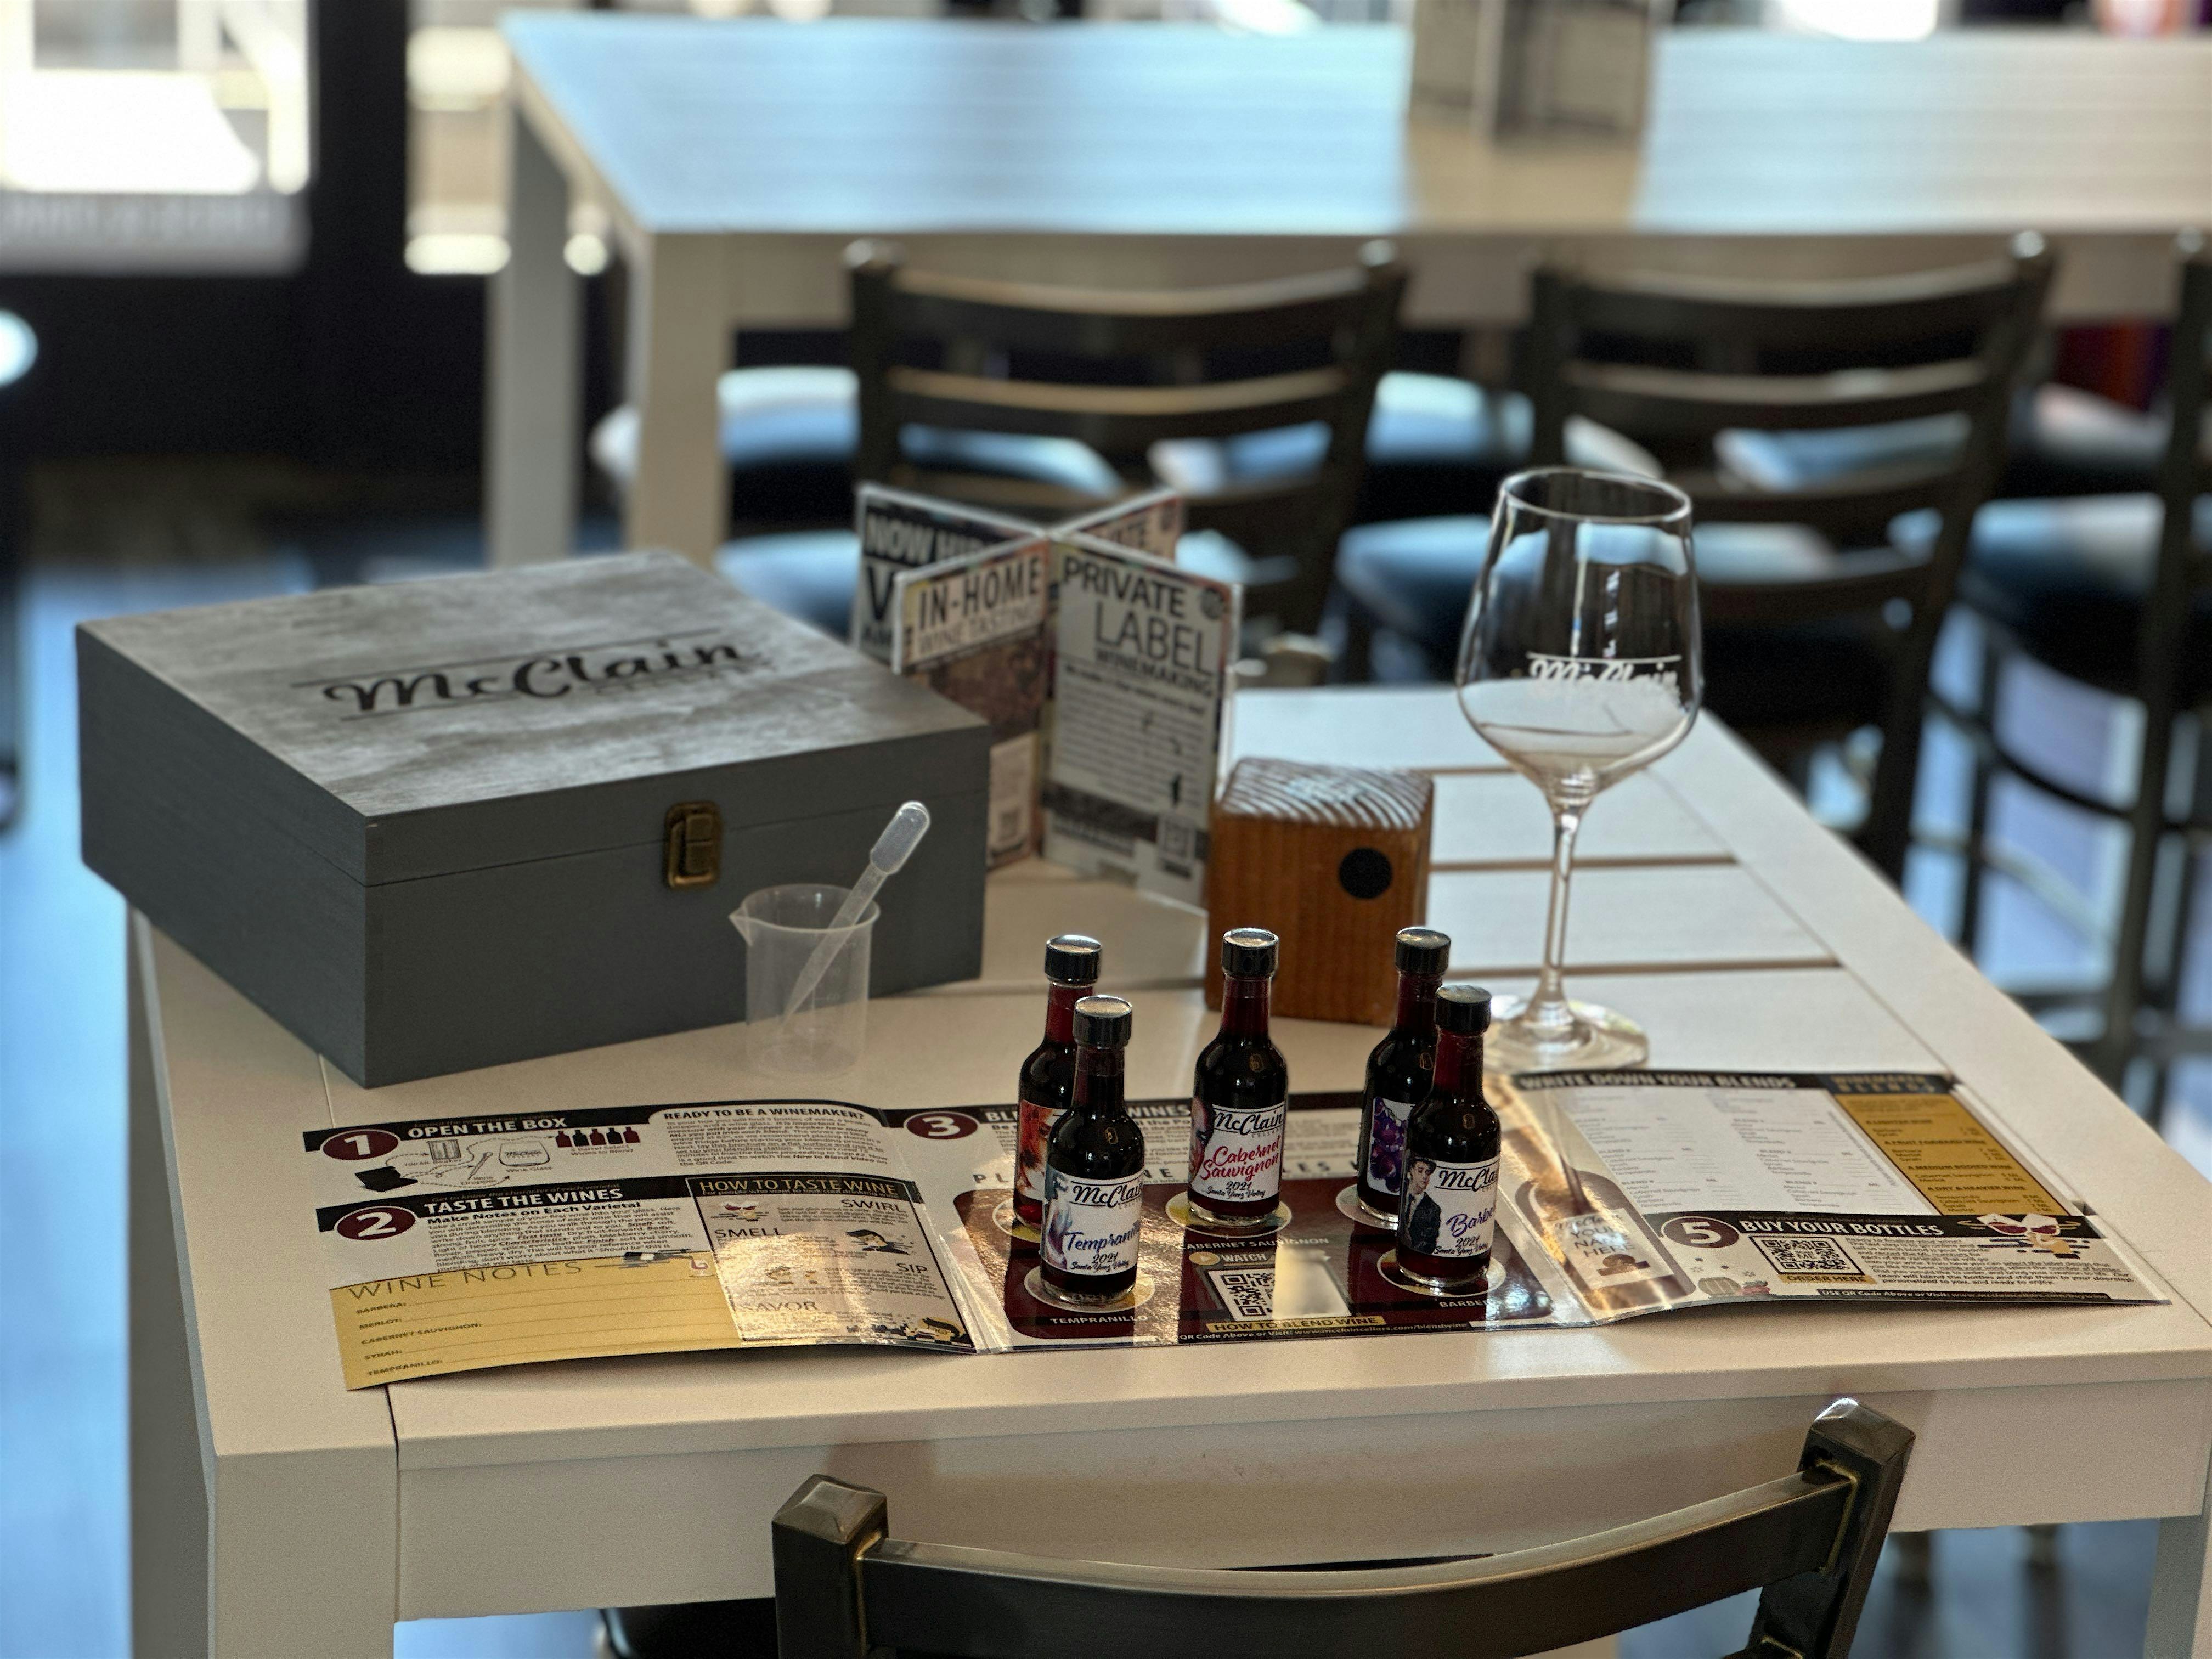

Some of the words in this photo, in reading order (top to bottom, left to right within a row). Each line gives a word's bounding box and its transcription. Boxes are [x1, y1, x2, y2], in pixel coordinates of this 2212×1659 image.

[917, 556, 1040, 631] IN-HOME
[1064, 554, 1186, 620] PRIVATE
[1096, 599, 1213, 678] LABEL
[323, 637, 755, 712] McClain
[663, 1110, 709, 1120] READY
[735, 1108, 757, 1117] BE
[758, 1108, 769, 1116] A
[769, 1107, 865, 1120] WINEMAKER?
[408, 1125, 469, 1138] OPEN
[472, 1121, 517, 1133] THE
[522, 1118, 567, 1130] BOX
[923, 1116, 962, 1137] 3
[1215, 1110, 1282, 1136] McClain
[344, 1134, 371, 1156] 1
[1212, 1135, 1281, 1166] Cabernet
[1200, 1153, 1279, 1182] Sauvignon
[700, 1181, 748, 1193] HOW
[753, 1180, 778, 1190] TO
[782, 1179, 841, 1191] TASTE
[843, 1180, 899, 1196] WINE
[1207, 1186, 1226, 1196] Santa
[1226, 1190, 1245, 1200] Ynez
[1245, 1189, 1266, 1198] Valley
[1226, 1181, 1252, 1192] 2021
[424, 1198, 494, 1214] TASTE
[496, 1194, 543, 1207] THE
[546, 1188, 623, 1204] WINES
[841, 1199, 902, 1213] SWIRL
[427, 1216, 469, 1224] Make
[473, 1211, 517, 1220] Notes
[544, 1206, 579, 1214] Each
[582, 1201, 641, 1211] Varietal
[356, 1211, 397, 1237] 2
[1739, 1220, 1784, 1232] BUY
[1785, 1221, 1849, 1234] YOUR
[1849, 1223, 1945, 1235] BOTTLES
[714, 1227, 783, 1239] SMELL
[1681, 1222, 1722, 1244] 5
[1455, 1235, 1480, 1248] 2021
[1092, 1252, 1119, 1263] 2021
[1222, 1253, 1266, 1262] WATCH
[1434, 1246, 1455, 1254] Santa
[1456, 1248, 1474, 1256] Ynez
[896, 1262, 928, 1273] SIP
[1071, 1261, 1092, 1270] Santa
[1093, 1262, 1111, 1273] Ynez
[349, 1274, 446, 1300] WINE
[463, 1262, 582, 1284] NOTES
[356, 1302, 407, 1314] BARBERA:
[359, 1318, 403, 1330] MERLOT:
[1049, 1315, 1148, 1324] TEMPRANILLO
[1214, 1323, 1252, 1331] HOW
[1282, 1318, 1334, 1328] BLEND
[1338, 1317, 1380, 1325] WINE
[362, 1331, 415, 1345] CABERNET
[417, 1323, 482, 1335] SAUVIGNON:
[364, 1350, 403, 1360] SYRAH:
[368, 1359, 443, 1375] TEMPRANILLO:
